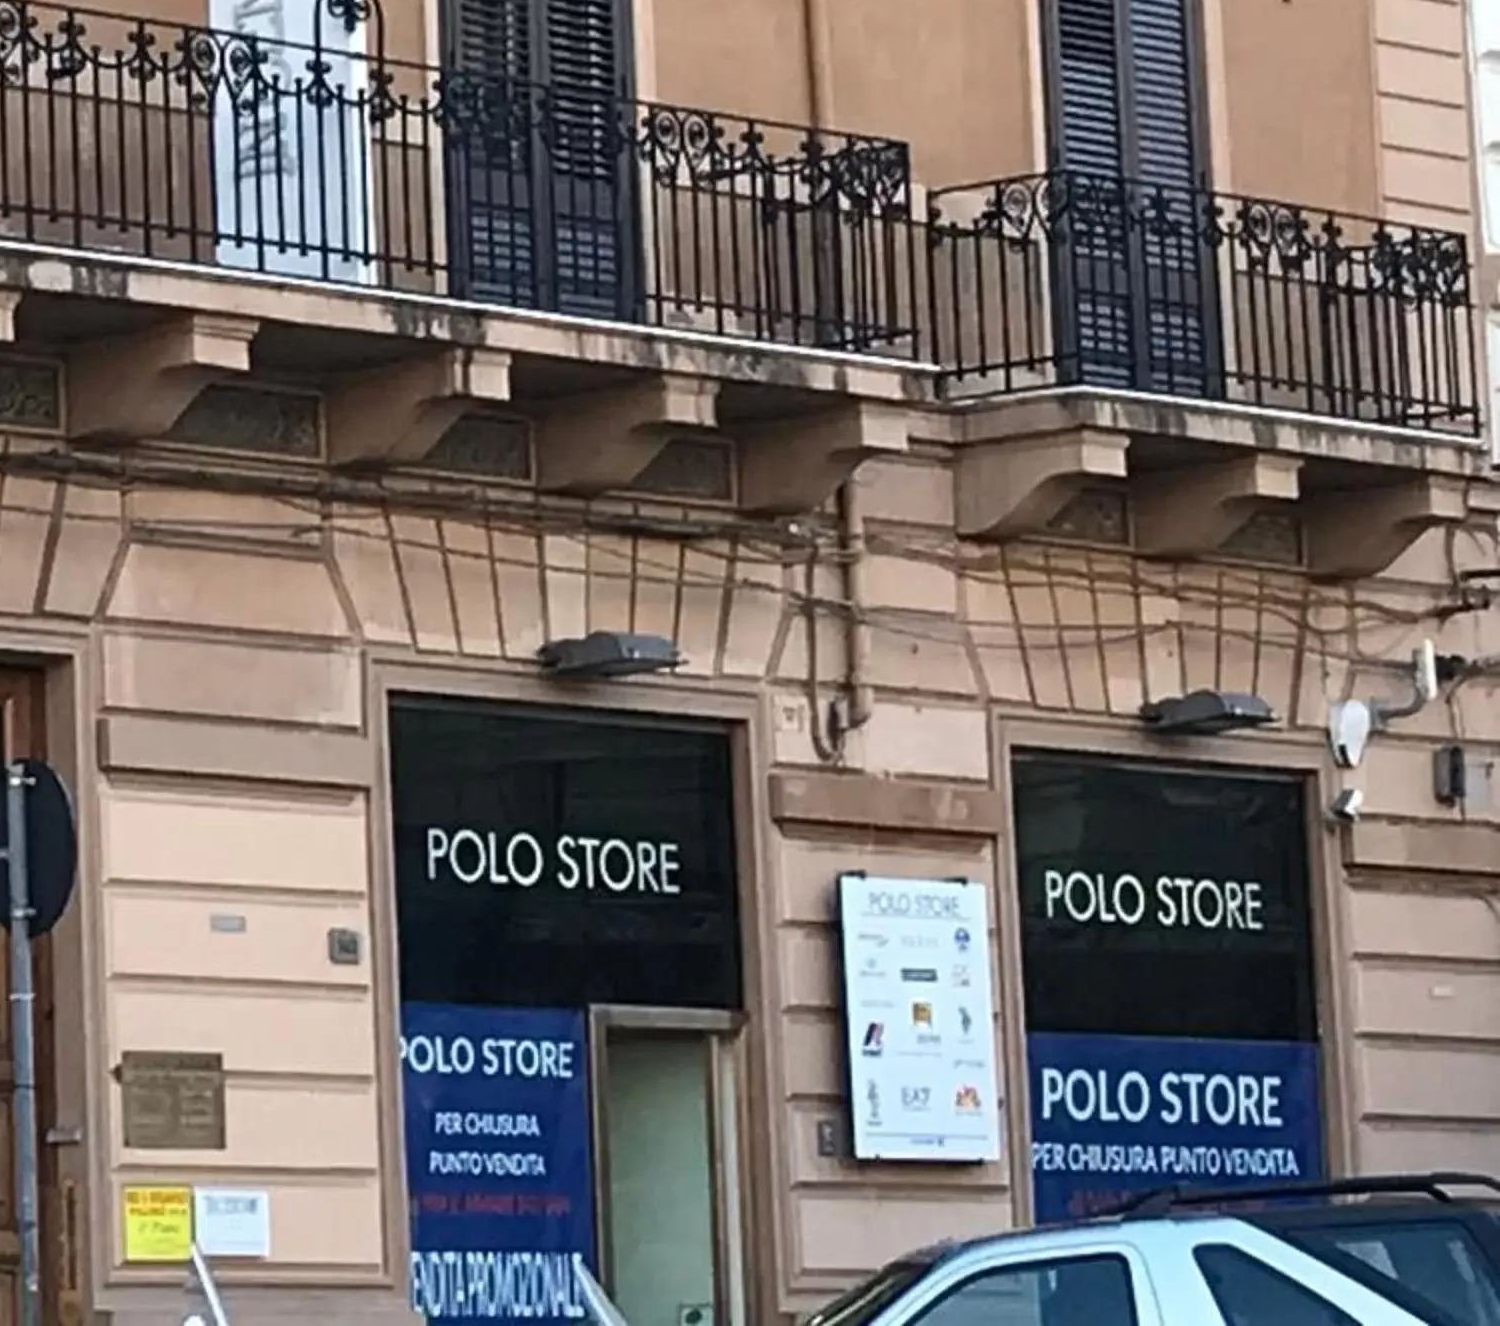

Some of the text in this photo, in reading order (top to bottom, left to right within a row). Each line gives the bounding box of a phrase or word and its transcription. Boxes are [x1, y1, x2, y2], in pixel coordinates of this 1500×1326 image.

[427, 827, 680, 893] POLO STORE
[868, 891, 912, 915] POLO
[1044, 870, 1263, 930] POLO STORE
[482, 1038, 574, 1078] STORE
[1041, 1068, 1283, 1127] POLO STORE
[435, 1111, 540, 1136] PER CHIUSURA
[429, 1150, 546, 1177] PUNTO VENDITA
[1031, 1142, 1300, 1176] PER CHIUSURA PUNTO VENDITA
